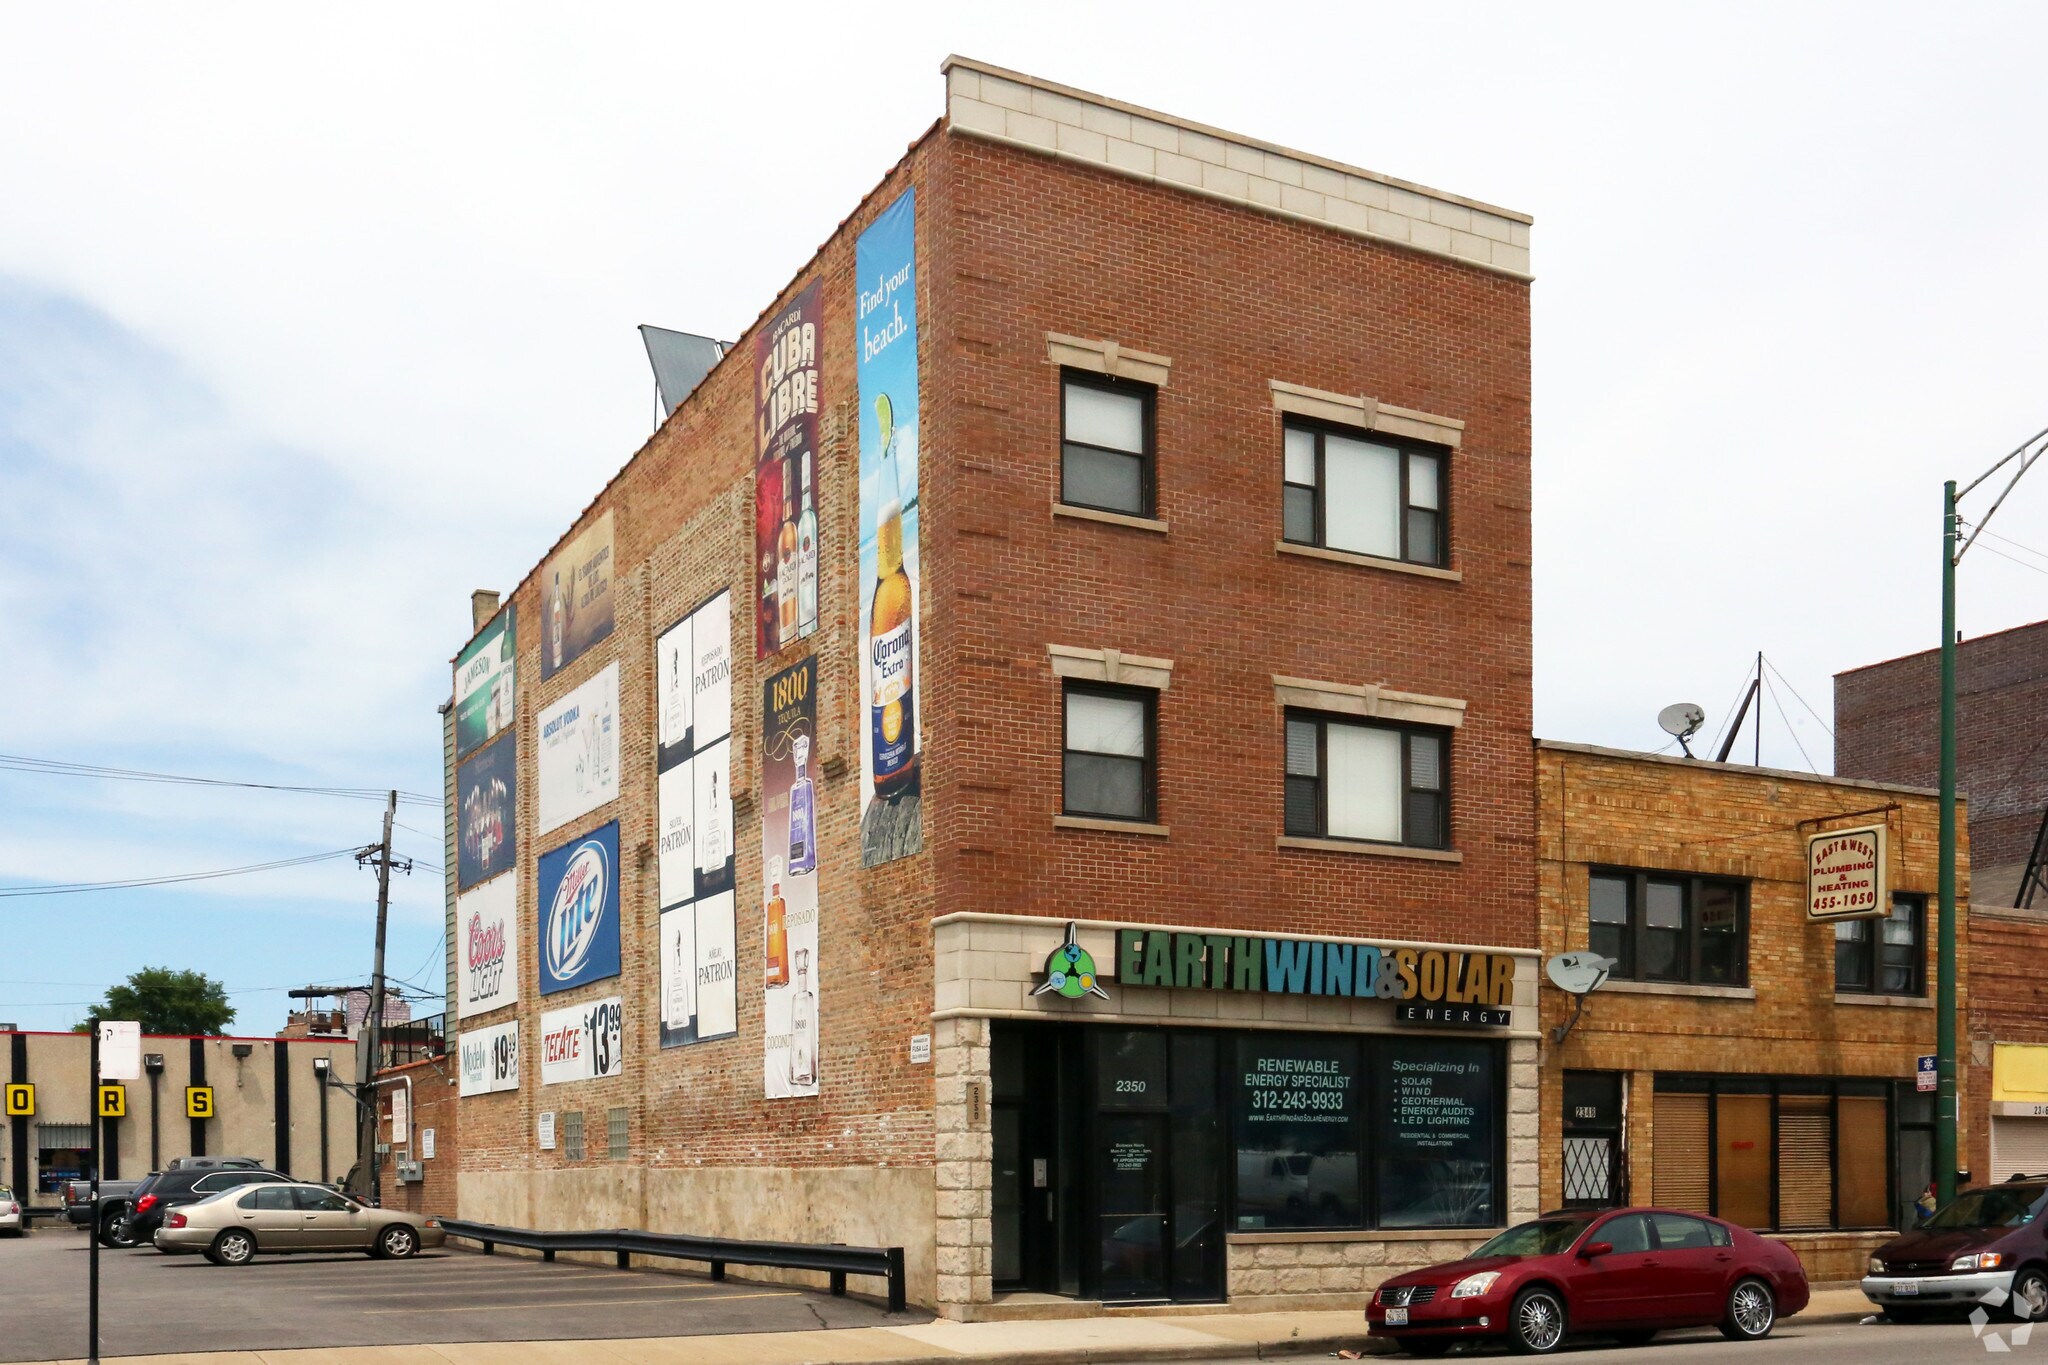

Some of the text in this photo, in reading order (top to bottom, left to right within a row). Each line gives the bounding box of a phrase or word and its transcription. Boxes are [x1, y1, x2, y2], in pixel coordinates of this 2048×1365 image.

[860, 262, 911, 320] Find your
[864, 299, 908, 364] beach.
[761, 322, 816, 409] CUBA
[759, 369, 818, 462] LIBRE
[873, 629, 908, 666] Corona
[464, 656, 491, 694] JAMESON
[695, 656, 730, 694] PATRÓN
[882, 659, 904, 678] Extra
[773, 666, 808, 712] 1800
[543, 712, 562, 740] ABSOLUT
[564, 704, 580, 728] VODKA
[778, 706, 802, 724] TEQUILA
[661, 822, 692, 854] PATRÓN
[1816, 839, 1874, 866] EAST & WEST
[562, 861, 590, 901] Miller
[1814, 861, 1874, 876] PLUMBING
[1818, 880, 1869, 893] HEATING
[1814, 892, 1874, 910] 455-1050
[558, 874, 598, 972] Lite
[468, 912, 506, 972] Coors
[469, 960, 504, 1002] LIGHT
[698, 956, 733, 986] PATRÓN
[1117, 928, 1516, 1006] EARTH WIND & SOLAR
[1408, 1007, 1506, 1024] ENERGY
[544, 1025, 580, 1063] TECATE
[1258, 1059, 1339, 1073] RENEWABLE
[1392, 1060, 1479, 1074] Specializing In
[1116, 1080, 1146, 1092] 2350
[1245, 1074, 1350, 1088] ENERGY SPECIALIST
[1401, 1077, 1432, 1086] SOLAR
[1401, 1087, 1431, 1095] WIND
[1253, 1090, 1343, 1110] 312-243-9933
[1401, 1097, 1465, 1106] GEOTHERMAL
[1401, 1107, 1474, 1116] ENERGY AUDITS
[1401, 1116, 1424, 1124] LED
